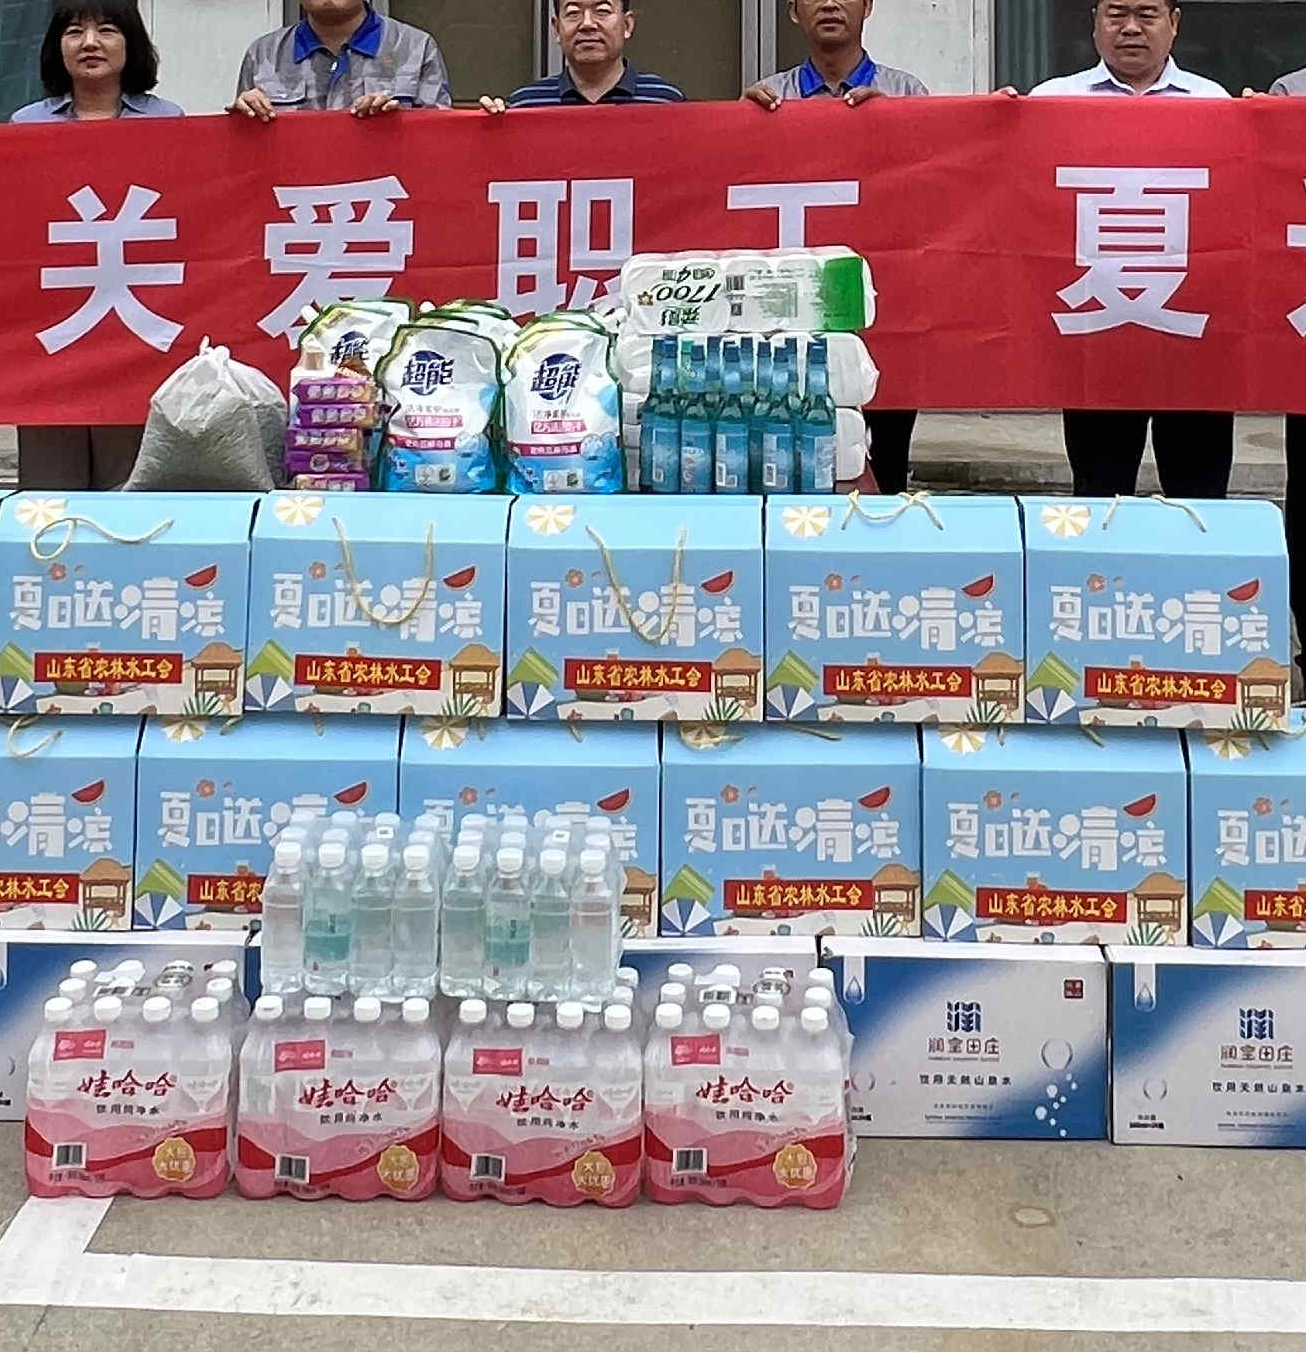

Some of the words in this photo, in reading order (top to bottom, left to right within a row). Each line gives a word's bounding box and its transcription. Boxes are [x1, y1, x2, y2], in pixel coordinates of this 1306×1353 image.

[401, 355, 454, 390] 超能
[531, 359, 582, 394] 超能
[10, 574, 226, 643] 夏日送清凉
[272, 575, 483, 644] 夏日送清凉
[528, 581, 743, 644] 夏日送清凉
[788, 585, 1003, 651] 夏日送清凉
[1049, 585, 1269, 653] 夏日送清凉
[45, 656, 174, 685] 山东省农林水工会
[306, 657, 431, 688] 山东省农林水工会
[575, 662, 702, 690] 山东省农林水工会
[833, 667, 962, 693] 山东省农林水工会
[1096, 671, 1228, 700] 山东省农林水工会
[684, 798, 900, 861] 夏日送清凉
[946, 803, 1166, 868] 夏日送清凉
[734, 881, 862, 909] 山东省农林水工会
[987, 893, 1118, 921] 山东省农林水工会
[77, 1068, 175, 1098] 娃哈哈
[299, 1077, 397, 1109] 娃哈哈
[496, 1084, 593, 1112] 娃哈哈
[696, 1074, 793, 1104] 娃哈哈
